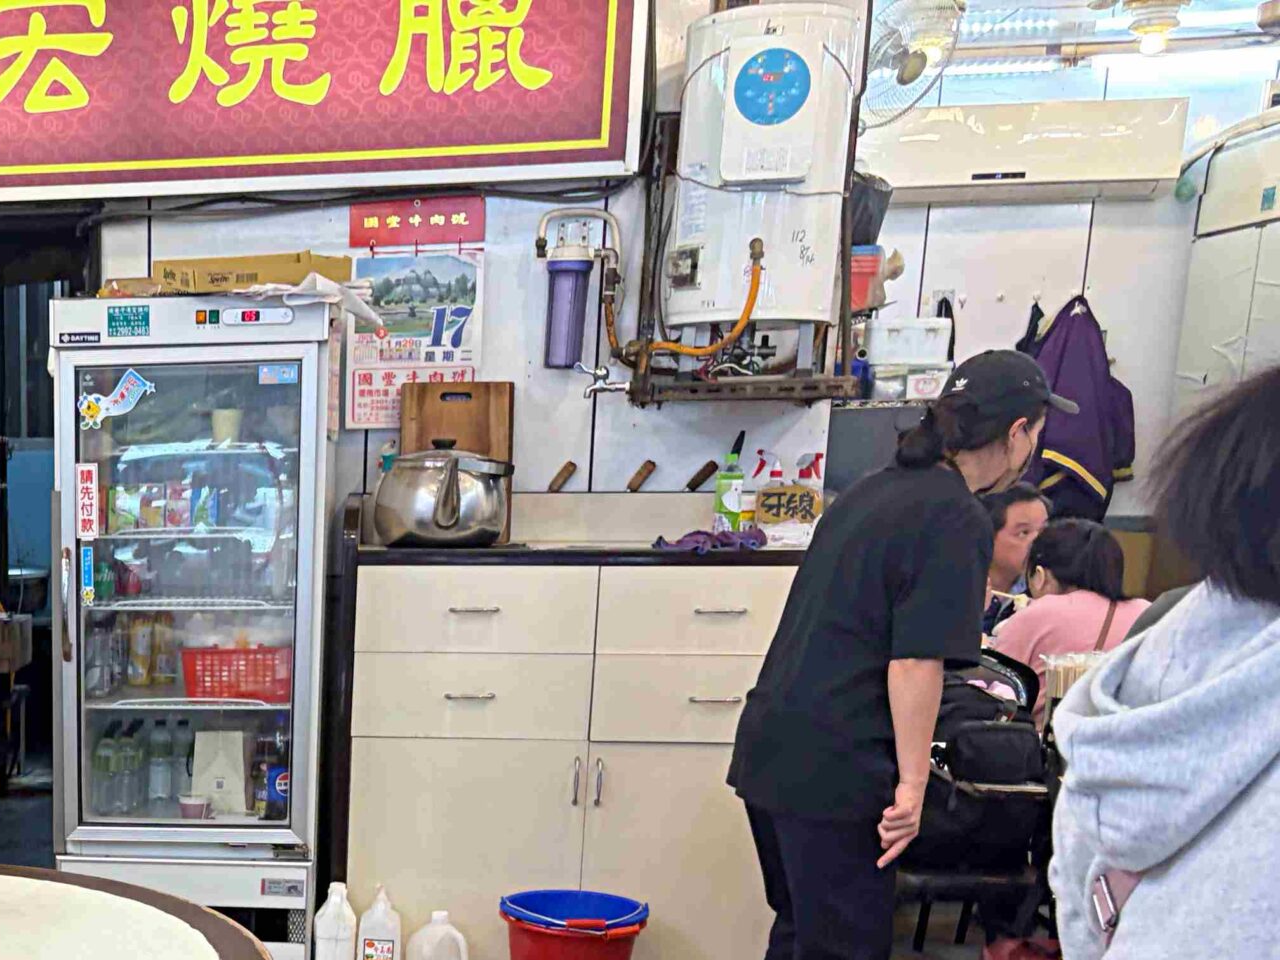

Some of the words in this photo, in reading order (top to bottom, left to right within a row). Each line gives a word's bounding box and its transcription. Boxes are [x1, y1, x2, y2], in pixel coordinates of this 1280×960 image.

[427, 305, 473, 349] 17
[424, 349, 473, 362] 星期二
[80, 469, 95, 534] 請先付款
[760, 492, 816, 519] 牙線
